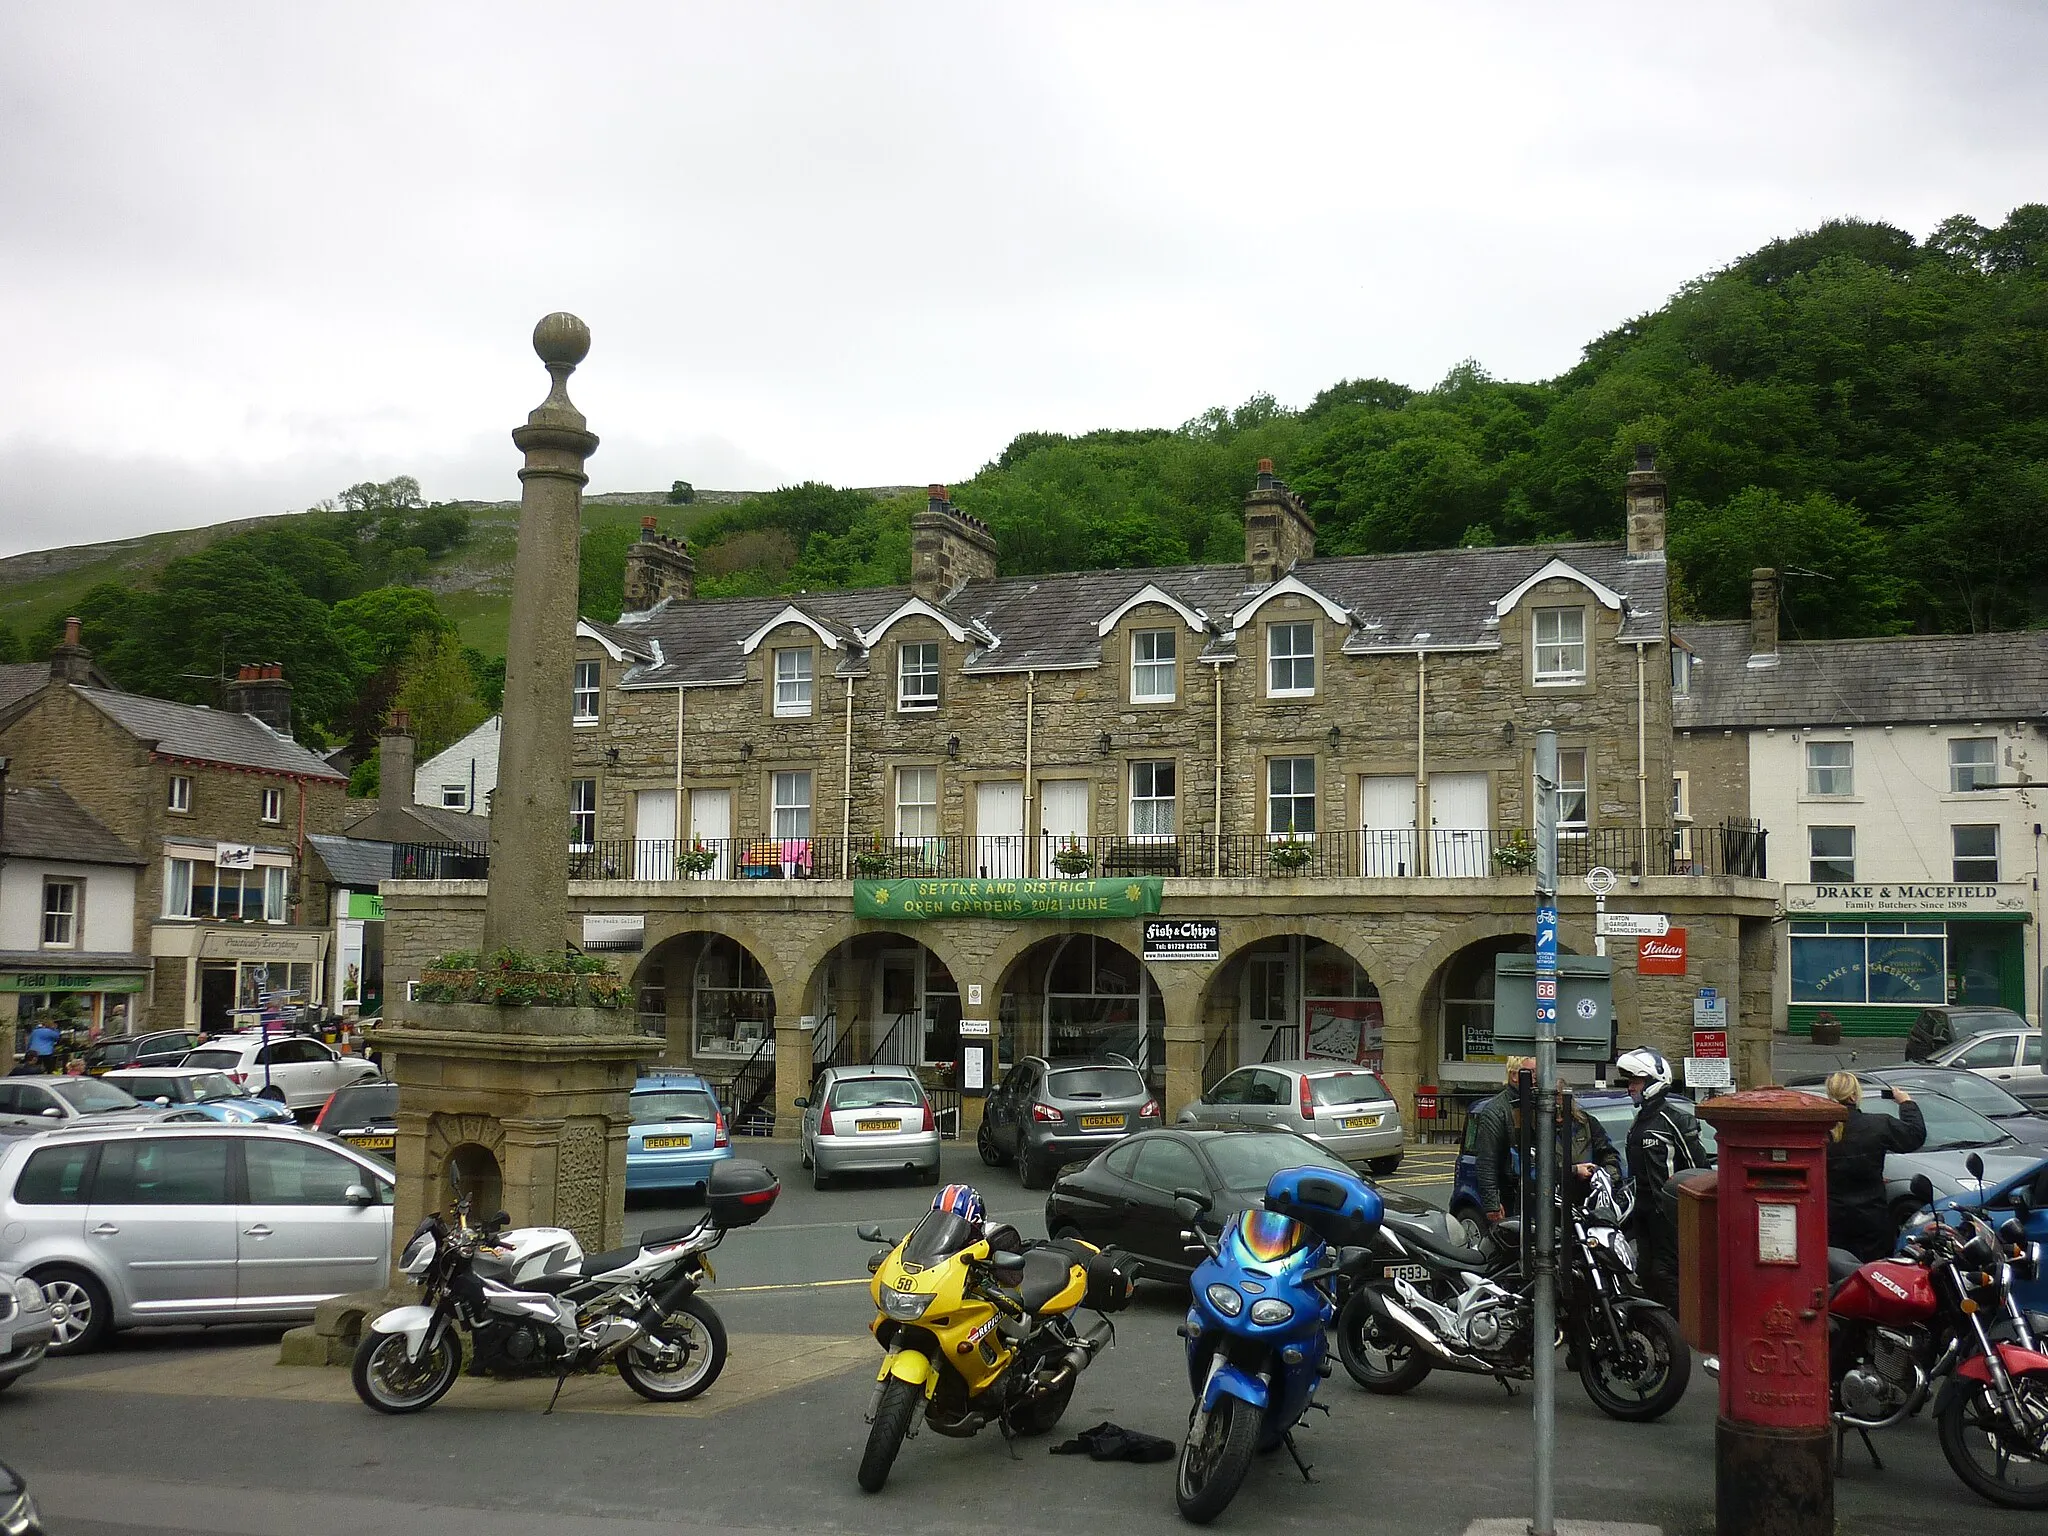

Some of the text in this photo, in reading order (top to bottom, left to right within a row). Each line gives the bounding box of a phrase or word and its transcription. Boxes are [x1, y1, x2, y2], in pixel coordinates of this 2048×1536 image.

[919, 881, 1097, 895] SETTLE AND DISTRICT
[1815, 886, 1997, 898] DRAKE & MACEFIELD
[904, 897, 1108, 912] OPEN GARDENS 20/21 JUNE
[1845, 901, 1967, 910] Family Butchers Since 1898
[1146, 923, 1217, 939] Fish & Chips
[1640, 940, 1683, 956] Italian
[16, 973, 46, 987] Field
[58, 973, 91, 987] Home
[1815, 966, 1848, 991] DRAKE
[1868, 962, 1921, 992] MACEFIELD
[1538, 984, 1554, 996] 68
[1706, 1000, 1713, 1009] P
[861, 1122, 881, 1130] PK05
[1084, 1116, 1104, 1125] YG62
[648, 1137, 687, 1147] PE06 YJL
[896, 1277, 913, 1291] 58
[1871, 1271, 1909, 1300] SUZUKI
